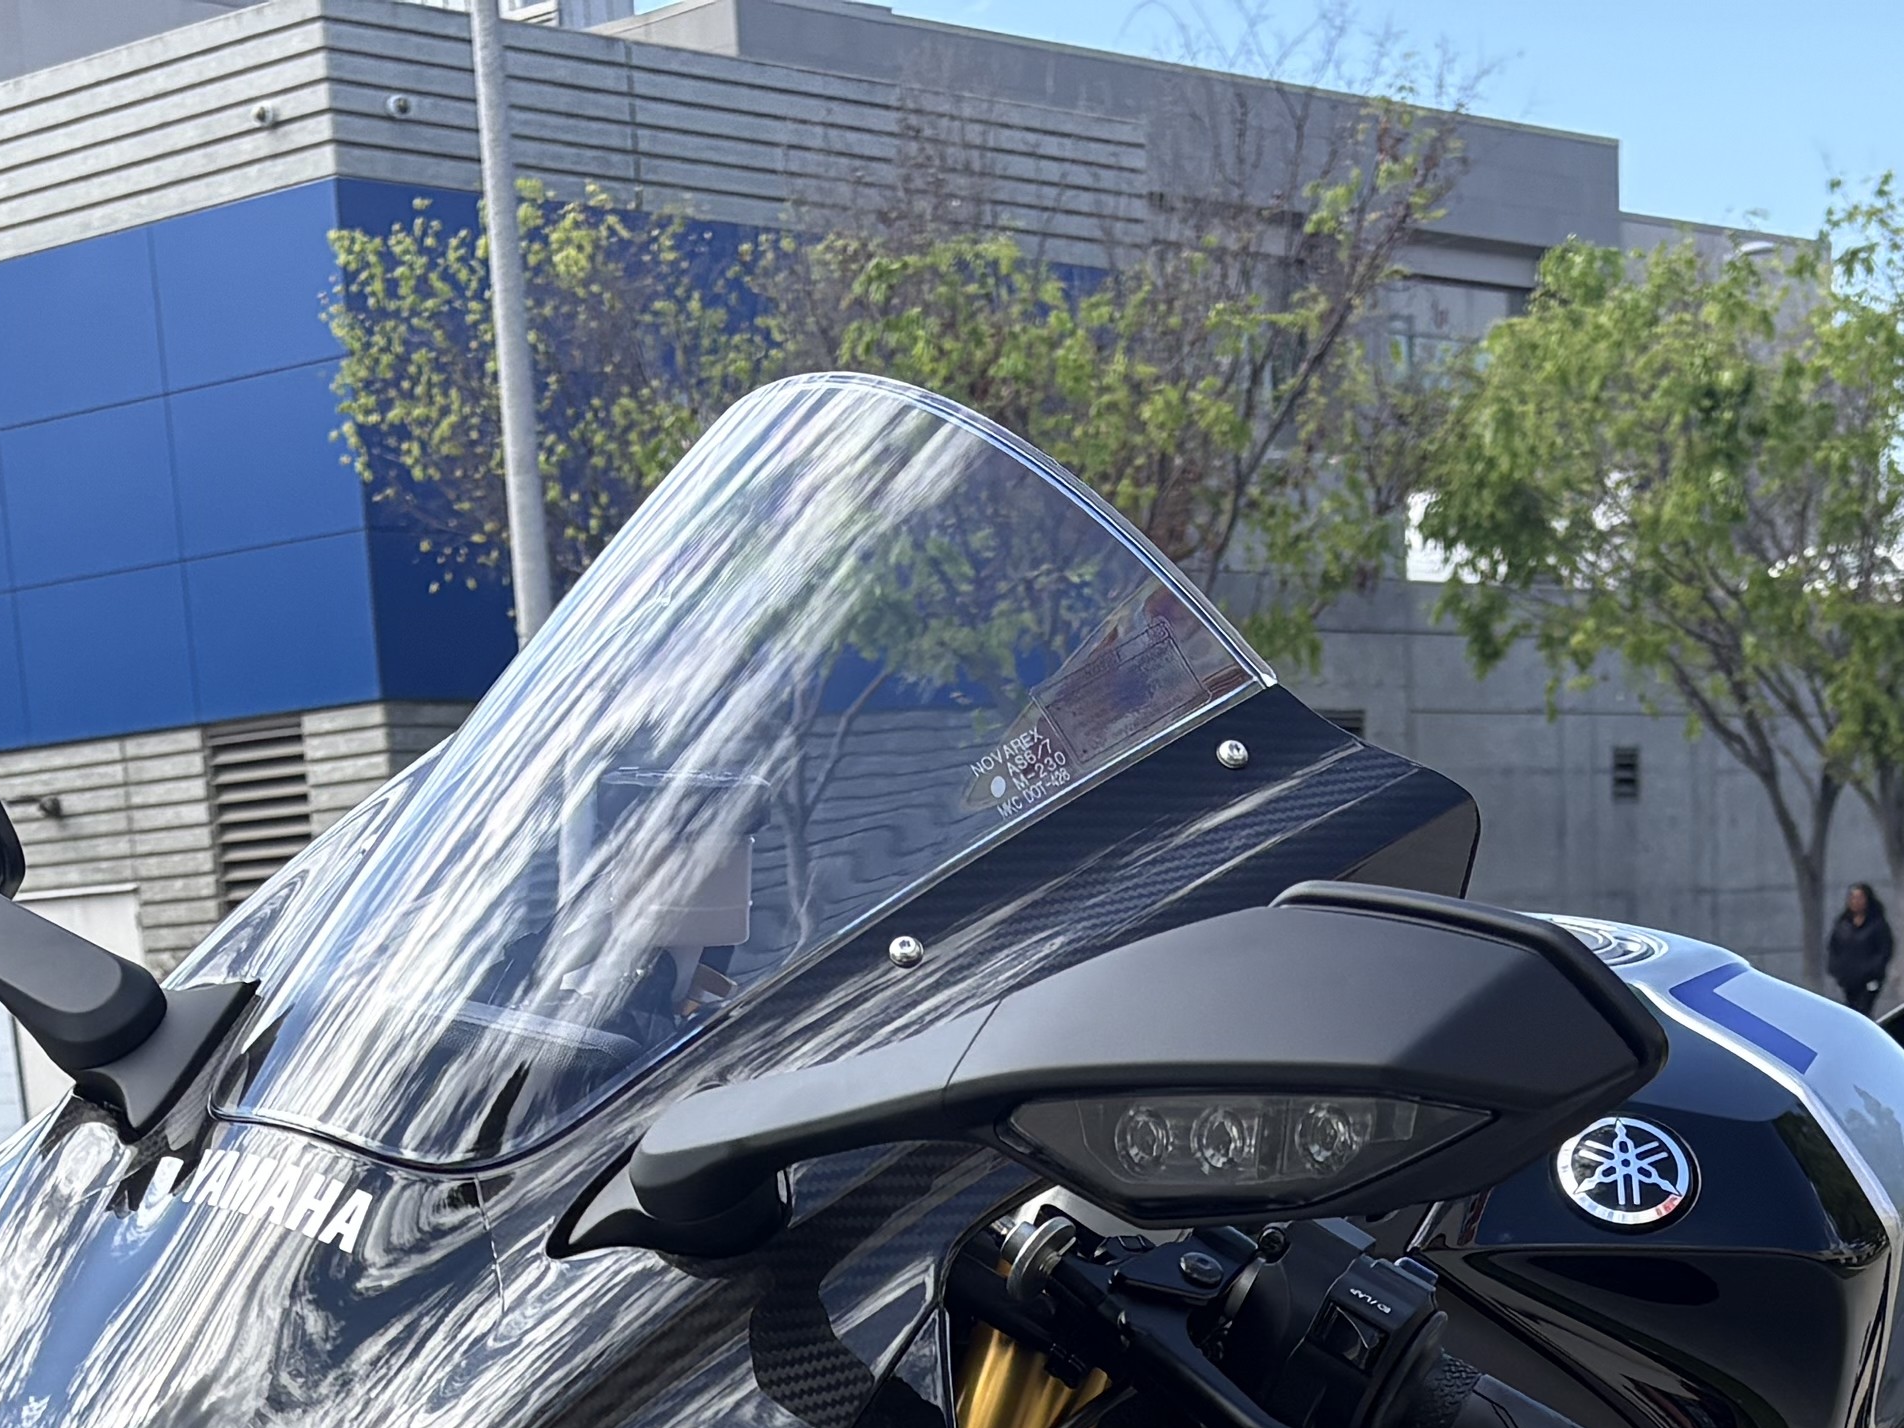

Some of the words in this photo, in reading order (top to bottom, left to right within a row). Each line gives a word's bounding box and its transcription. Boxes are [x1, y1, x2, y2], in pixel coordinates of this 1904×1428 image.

[970, 726, 1043, 778] NOVAREX
[1007, 738, 1052, 776] AS6/7
[1012, 751, 1066, 791] M-230
